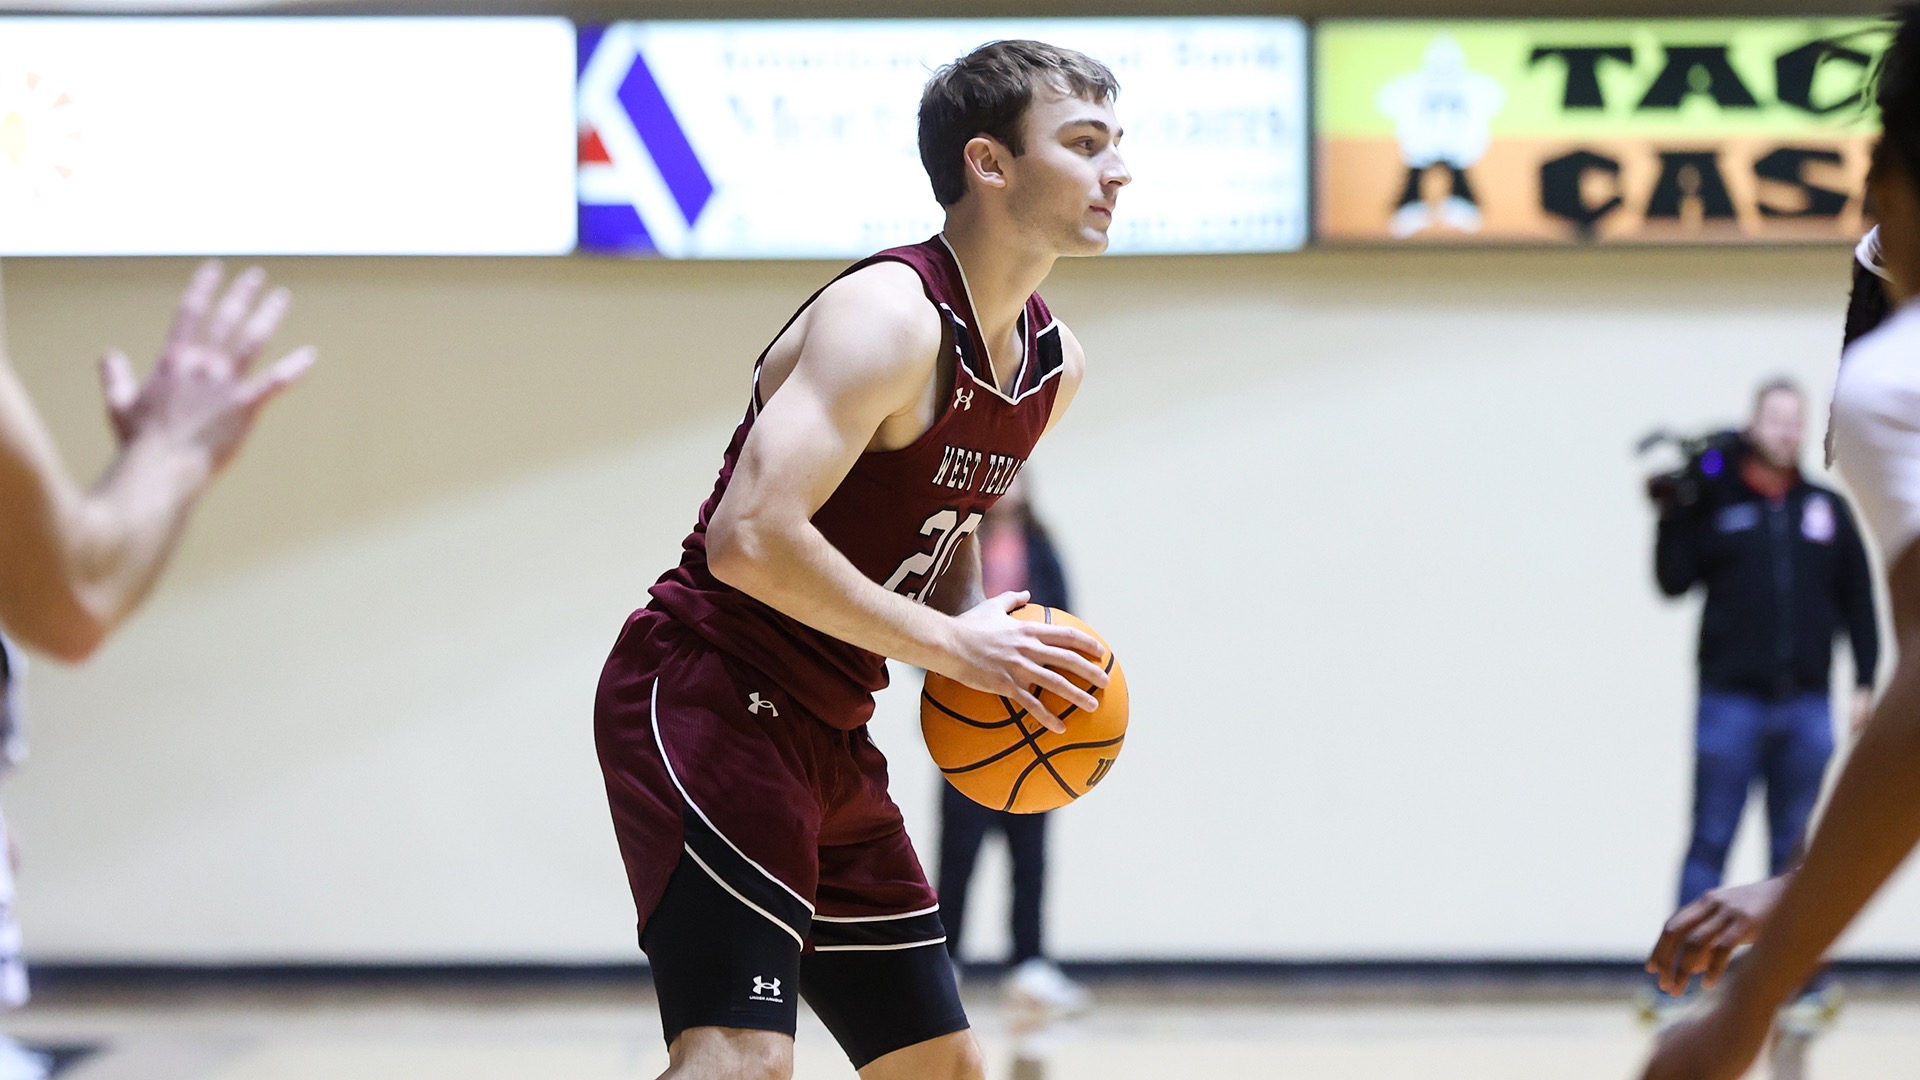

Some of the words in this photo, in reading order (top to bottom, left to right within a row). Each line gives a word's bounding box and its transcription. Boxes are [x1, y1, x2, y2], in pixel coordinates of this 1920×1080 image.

[1528, 39, 1872, 113] TAC
[1541, 148, 1851, 228] CAS
[932, 445, 982, 491] WEST
[979, 454, 1026, 494] TEXA
